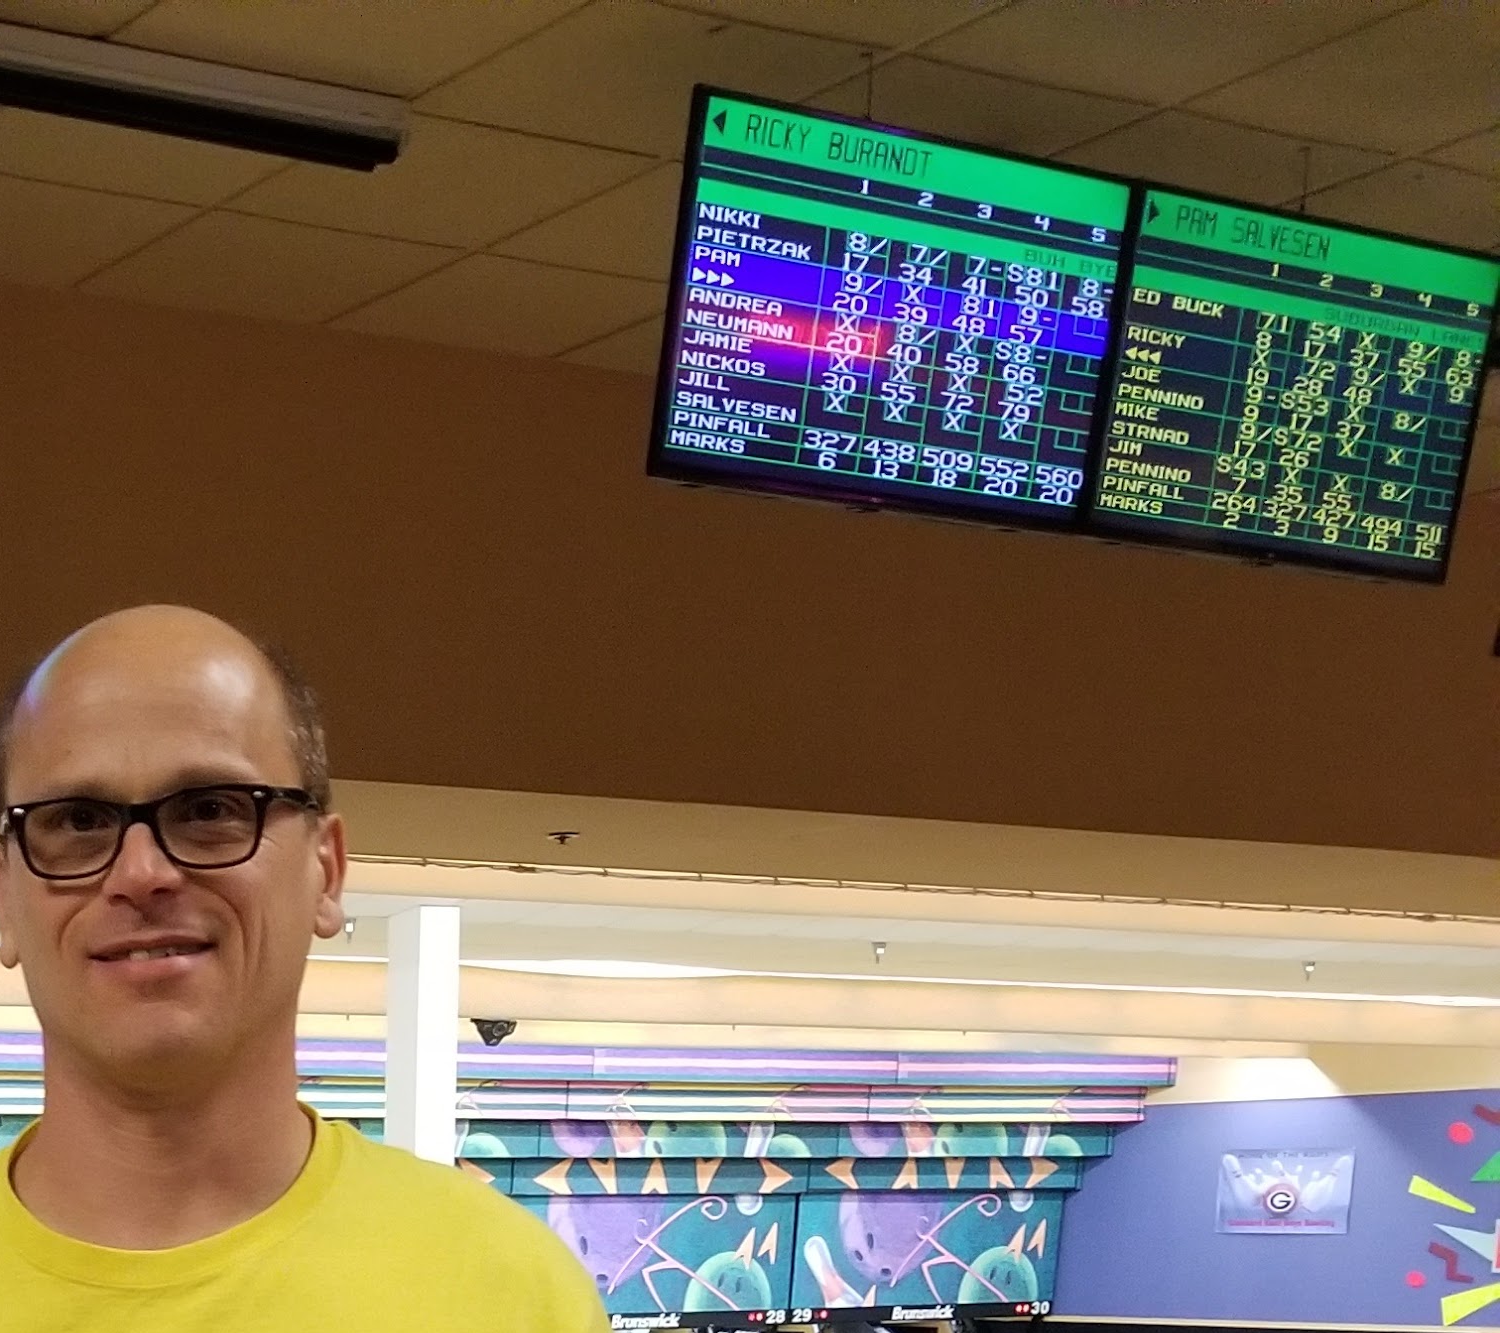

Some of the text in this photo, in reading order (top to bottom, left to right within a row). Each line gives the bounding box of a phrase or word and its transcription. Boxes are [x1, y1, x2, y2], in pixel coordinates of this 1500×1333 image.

[745, 113, 932, 178] RICKY BURANDT
[698, 203, 761, 230] NIKKI
[860, 179, 1107, 243] 1 2 3 4 5
[1176, 205, 1331, 260] PAM SALVESEN
[694, 245, 741, 267] PAM
[696, 224, 1105, 319] PIETRZAK 17 34 41 50 58
[689, 287, 783, 317] ANDREA
[1132, 287, 1225, 319] ED BUCK
[1319, 274, 1334, 289] 2
[1370, 284, 1384, 298] 3
[1418, 292, 1432, 308] 4
[686, 308, 794, 341] NEUMANN
[833, 291, 1043, 346] 20 39 48 57
[684, 330, 754, 353] JAMIE
[1127, 325, 1187, 349] RICKY
[681, 349, 766, 376] NICKOS
[1121, 365, 1162, 383] JOE
[678, 371, 730, 391] JILL
[676, 391, 797, 422] SALVESEN
[1118, 383, 1204, 411] PENNINO
[1114, 401, 1160, 421] MIKE
[1111, 420, 1190, 446] STRNAD
[674, 410, 1084, 489] PINFALL 327 438 509 552 560
[1108, 439, 1143, 456] JIM
[670, 430, 1073, 505] MARKS 6 13 18 20 20
[1105, 457, 1191, 483] PENNINO
[1102, 475, 1185, 501] PINFALL
[1212, 492, 1257, 515] 264
[1262, 500, 1308, 522] 327
[1312, 507, 1357, 529] 427
[1361, 515, 1403, 537] 494
[1099, 493, 1436, 560] MARKS 2 3 9 15 15
[1270, 1191, 1293, 1210] G
[611, 1310, 683, 1330] Brunswick
[765, 1308, 787, 1325] 28
[791, 1307, 813, 1324] 29
[891, 1303, 956, 1321] Brunswick
[1030, 1301, 1051, 1316] 30
